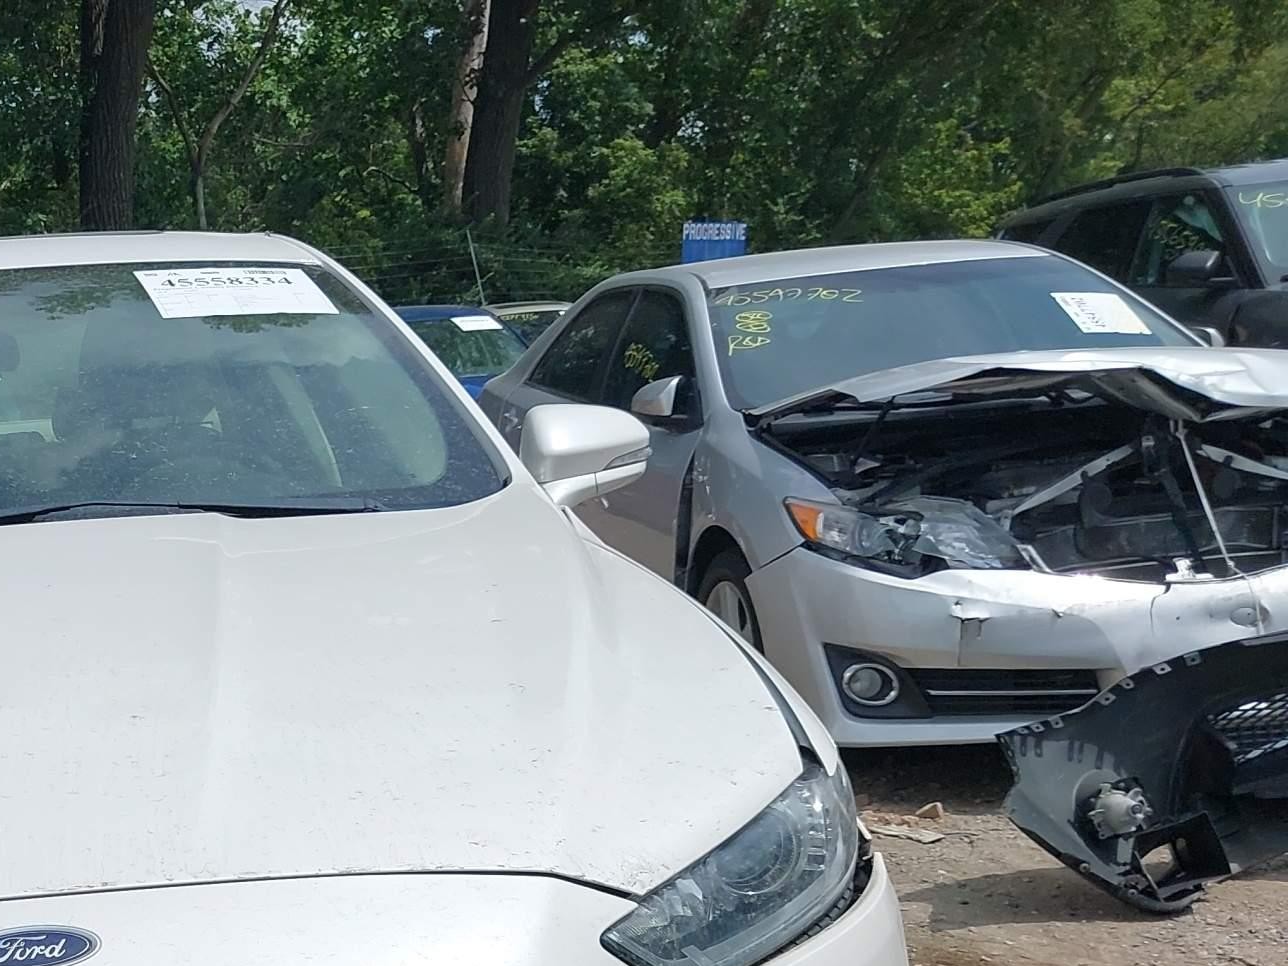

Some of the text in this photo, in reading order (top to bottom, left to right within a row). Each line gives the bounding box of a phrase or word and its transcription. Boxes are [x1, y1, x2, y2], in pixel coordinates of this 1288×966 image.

[1238, 191, 1288, 208] 45
[682, 223, 747, 240] PROGRESSIVE
[161, 276, 294, 288] 45558334
